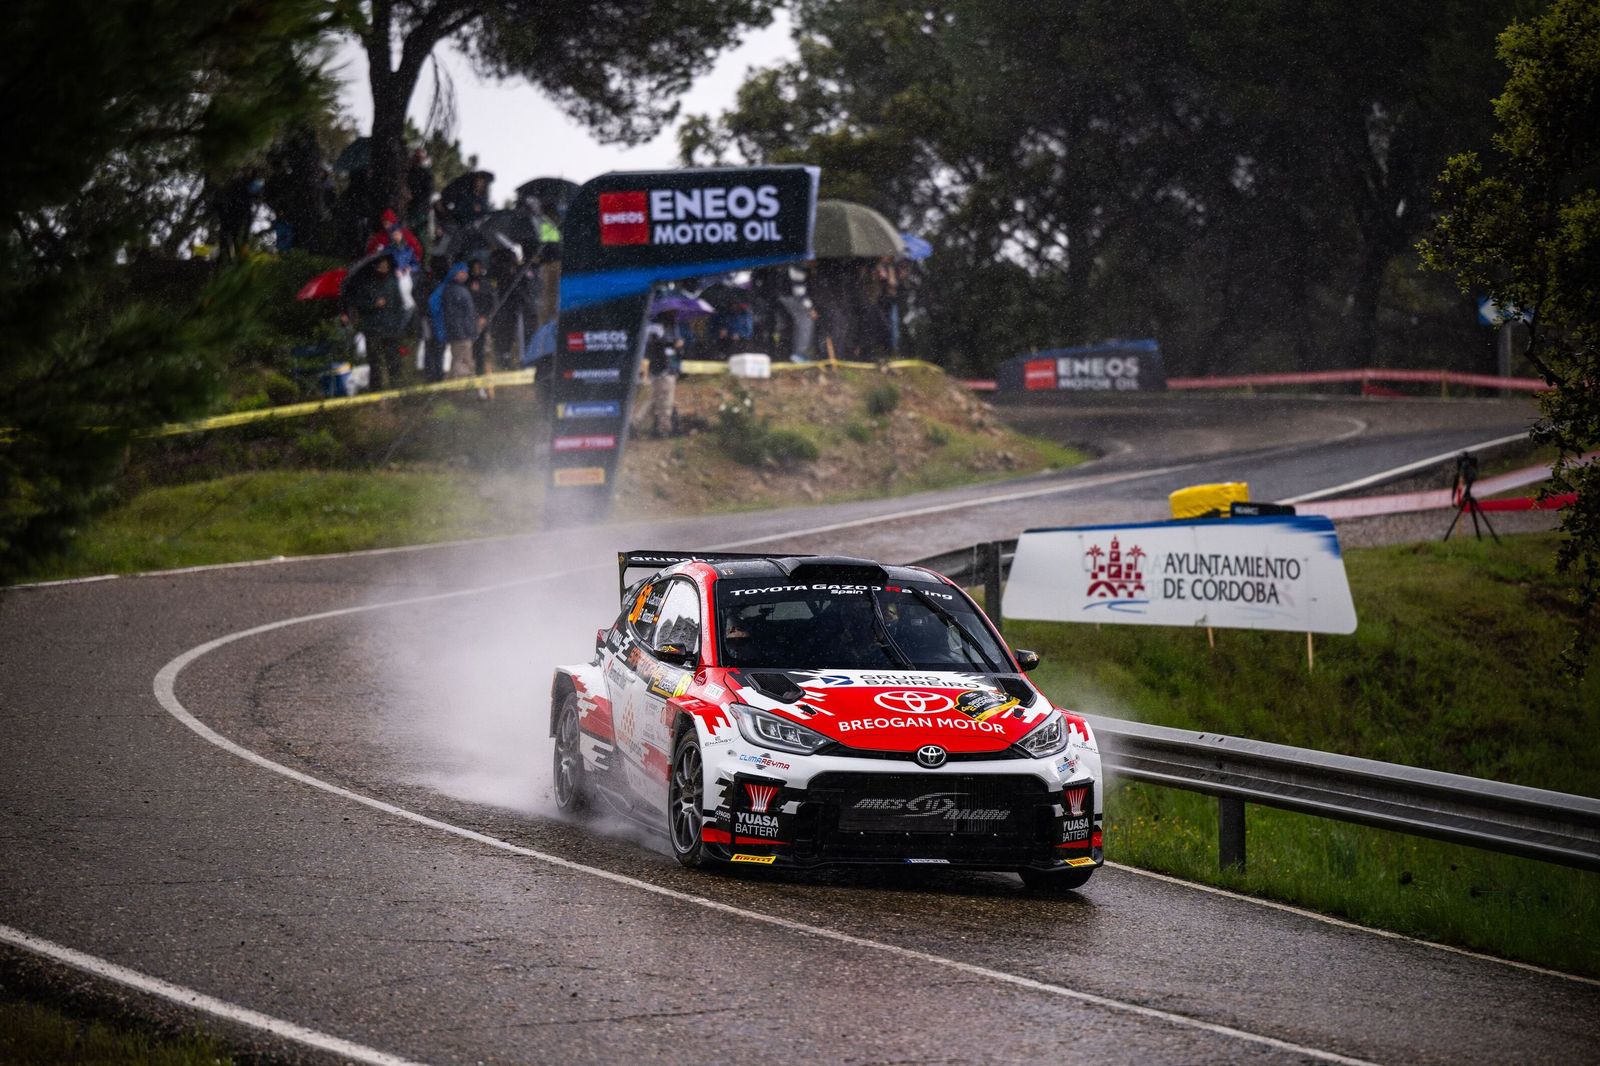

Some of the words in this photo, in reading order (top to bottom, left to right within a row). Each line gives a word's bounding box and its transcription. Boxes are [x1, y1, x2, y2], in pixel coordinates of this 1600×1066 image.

[650, 185, 781, 221] ENEOS
[603, 211, 644, 225] ENEOS
[653, 223, 737, 245] MOTOR
[743, 221, 782, 242] OIL
[1057, 357, 1139, 378] ENEOS
[1163, 552, 1301, 581] AYUNTAMIENTO
[730, 585, 808, 597] TOYOTA
[812, 583, 882, 592] GAZOO
[885, 585, 953, 600] Raing
[1163, 578, 1186, 600] DE
[1191, 575, 1280, 605] CÓRDOBA
[860, 674, 941, 682] GRUPO
[863, 679, 980, 689] BARREIRO
[838, 717, 933, 732] BREOGAN
[938, 717, 1006, 735] MOTOR
[739, 754, 790, 770] CLIMAREYMA
[736, 812, 779, 828] YUASA
[1063, 817, 1089, 832] YUASA
[735, 823, 779, 838] BATTERY
[1062, 829, 1089, 842] BATTERY
